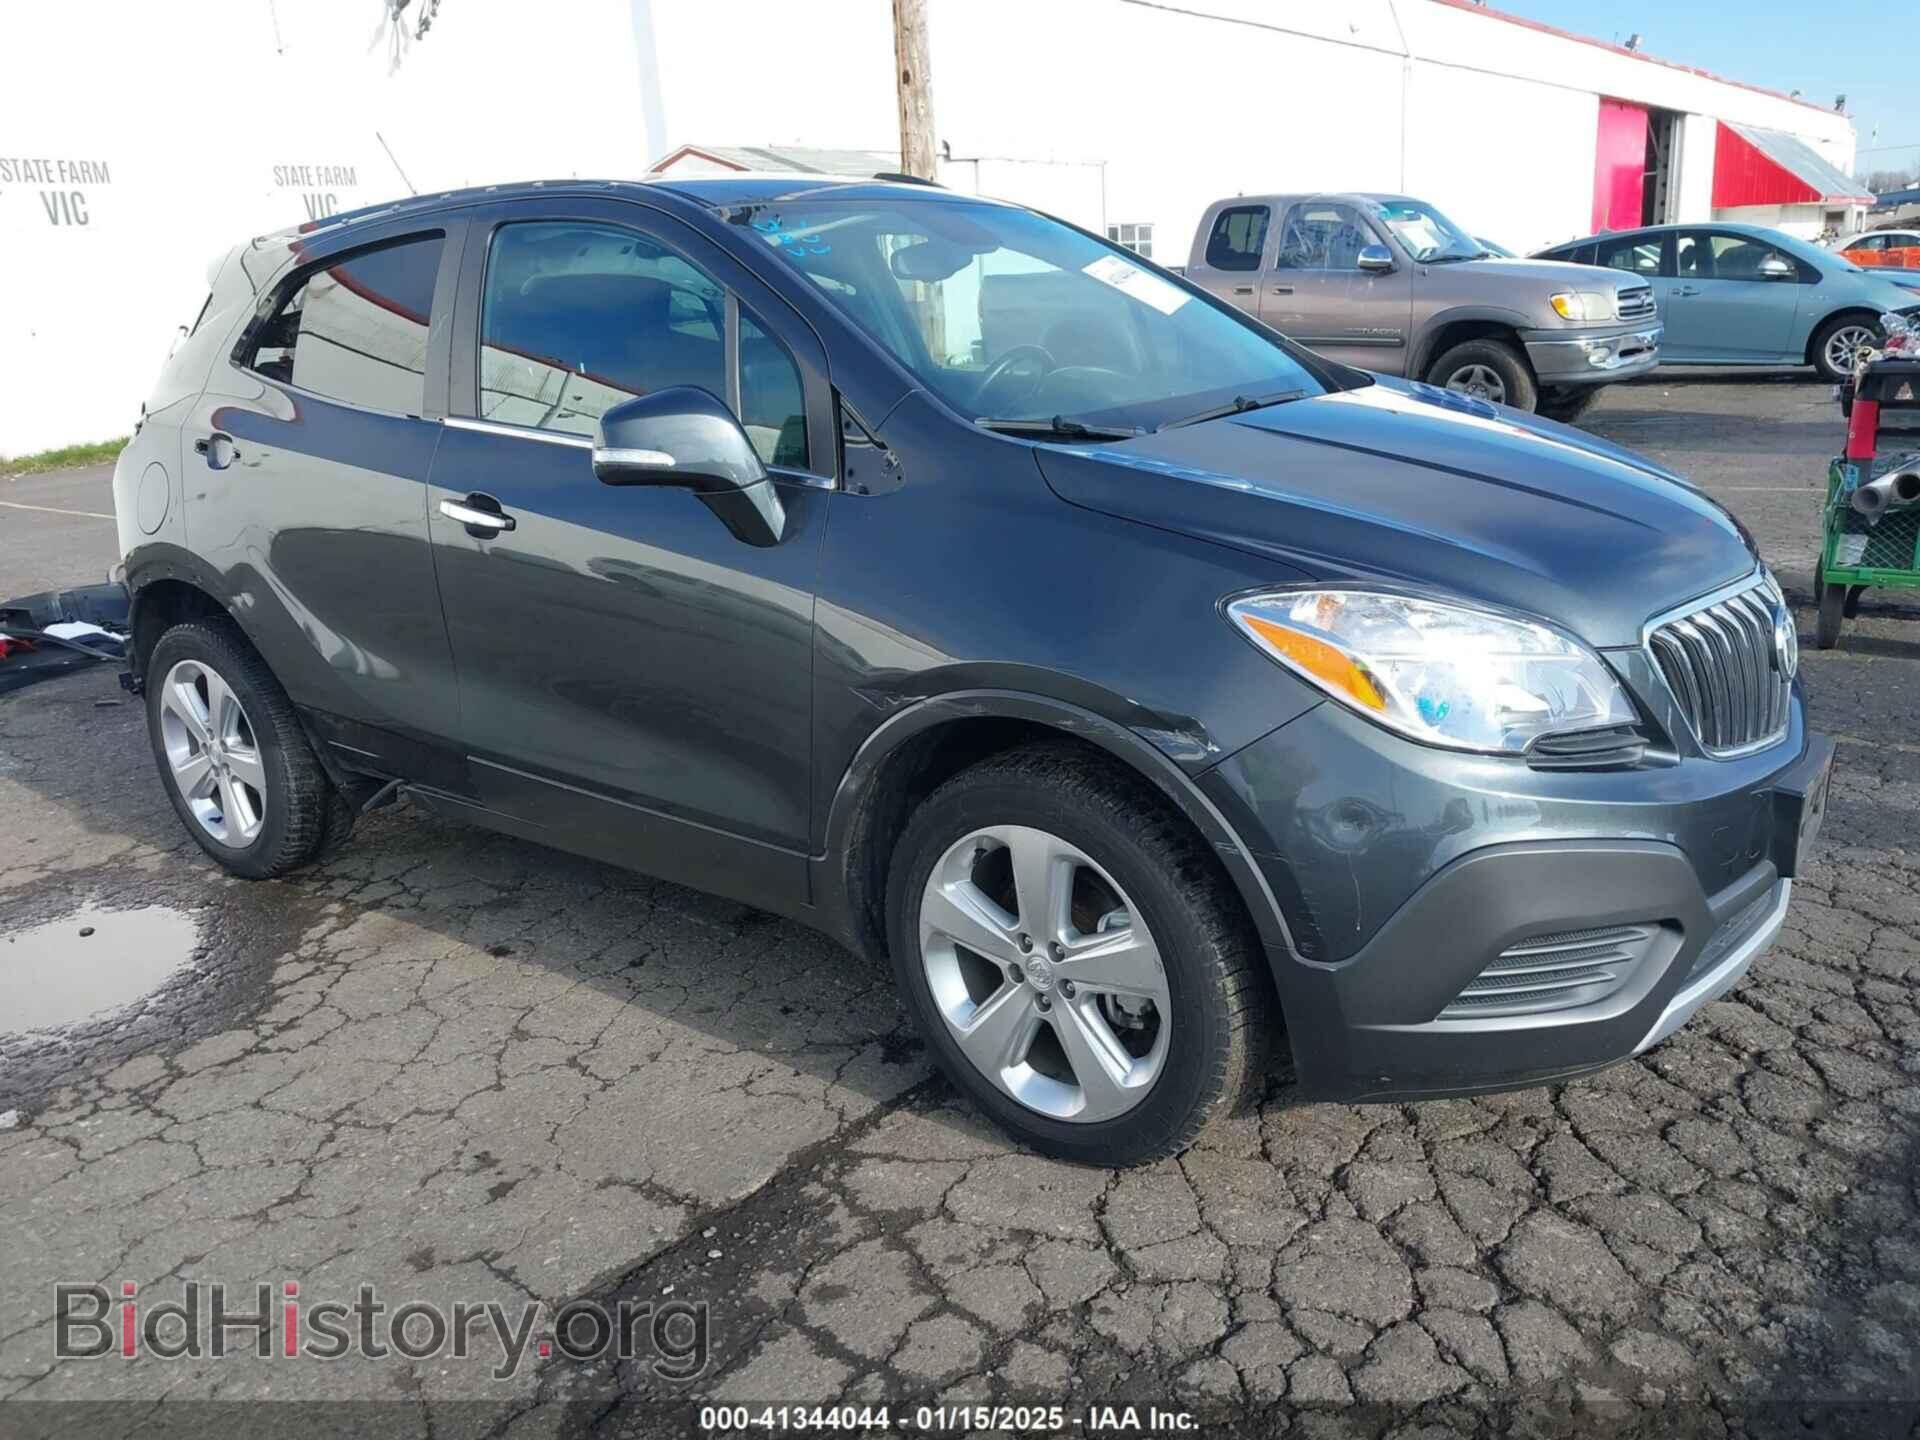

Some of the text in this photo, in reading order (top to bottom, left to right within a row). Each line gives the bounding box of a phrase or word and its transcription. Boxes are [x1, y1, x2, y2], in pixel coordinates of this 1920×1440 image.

[0, 158, 111, 185] STATE FARM
[273, 165, 358, 187] STATE FARM
[40, 190, 89, 226] VIC
[302, 193, 338, 221] VIC
